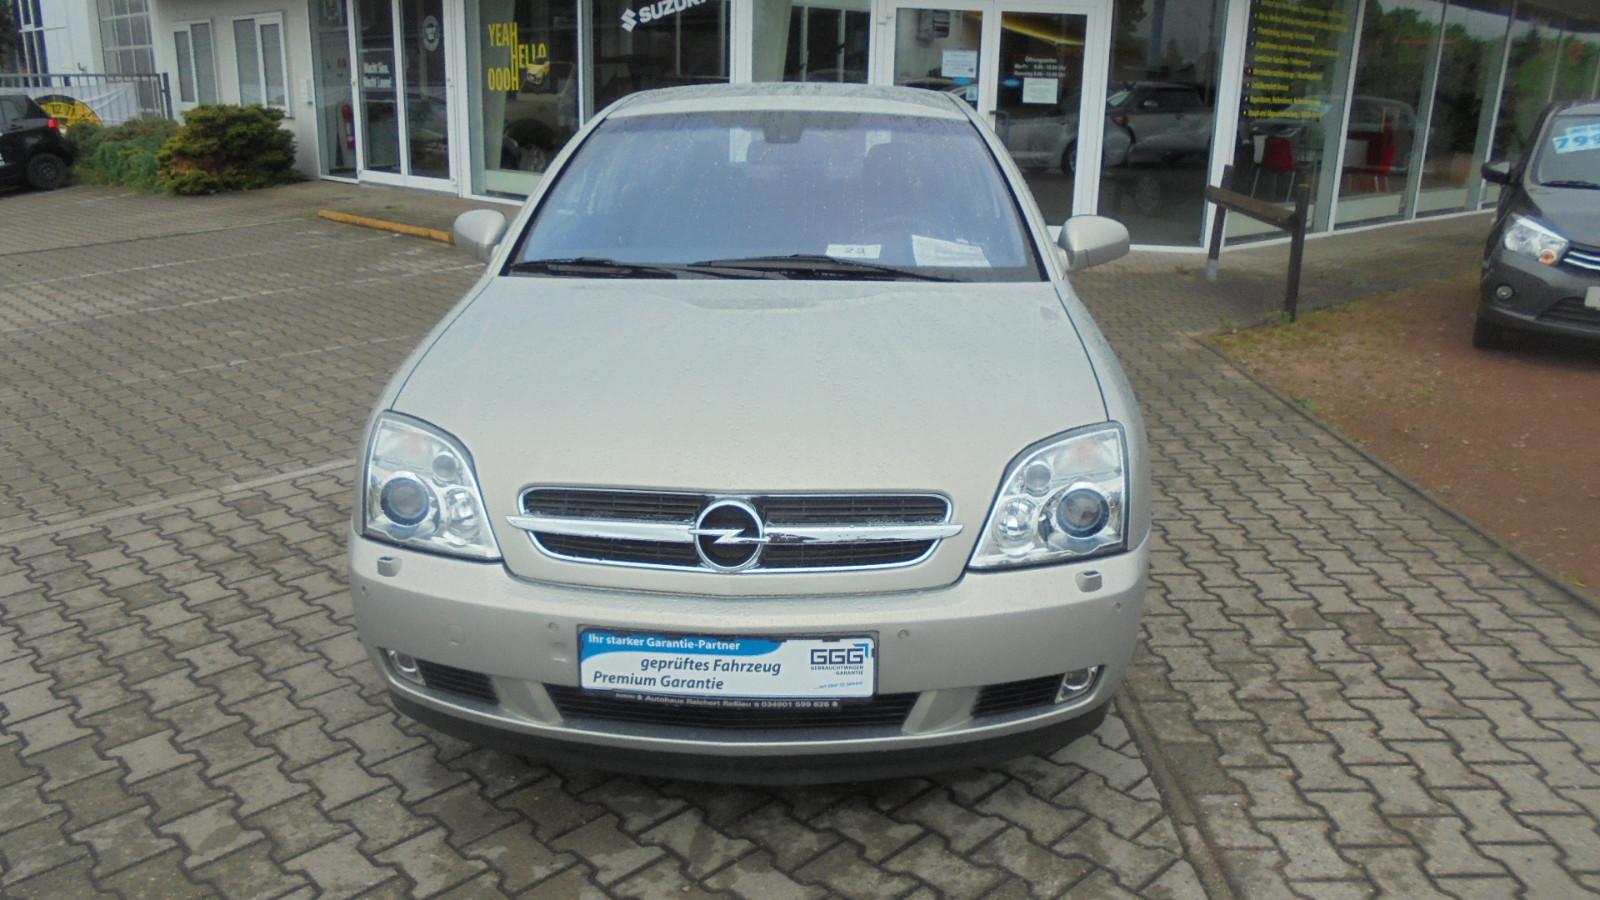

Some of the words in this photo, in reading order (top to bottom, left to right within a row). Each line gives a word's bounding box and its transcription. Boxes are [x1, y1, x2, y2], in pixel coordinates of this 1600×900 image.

[488, 22, 517, 47] YEAH
[488, 67, 519, 91] OOOH
[588, 633, 604, 644] Ihr
[606, 635, 644, 647] starker
[646, 637, 741, 651] Garantie-Partner
[640, 656, 710, 672] geprüftes
[713, 659, 781, 676] Fahrzeug
[810, 648, 864, 665] GGG
[593, 670, 657, 687] Premium
[660, 674, 724, 690] Garantie
